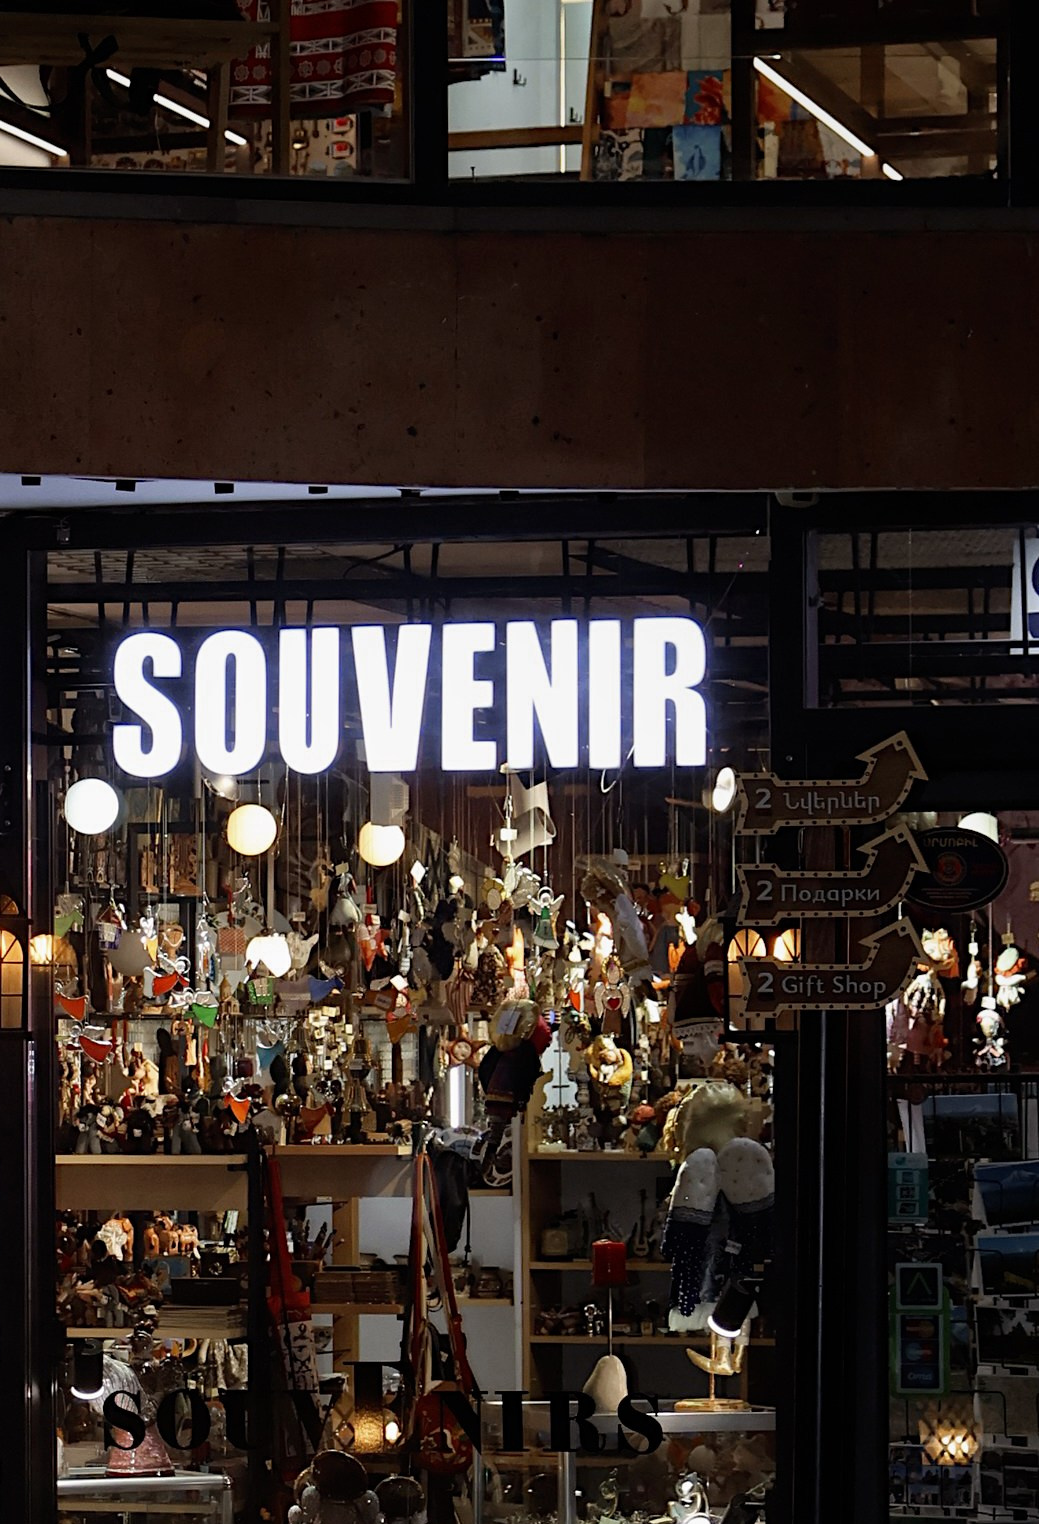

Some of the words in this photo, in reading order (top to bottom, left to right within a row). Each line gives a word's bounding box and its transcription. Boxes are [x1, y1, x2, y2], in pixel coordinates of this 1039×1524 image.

[112, 616, 707, 778] SOUVENIR
[754, 788, 772, 809] 2
[783, 791, 880, 815] Նվերներ
[756, 880, 773, 901] 2
[781, 884, 880, 908] Подарки
[757, 972, 775, 993] 2
[781, 975, 826, 997] Gift
[832, 974, 887, 1000] Shop
